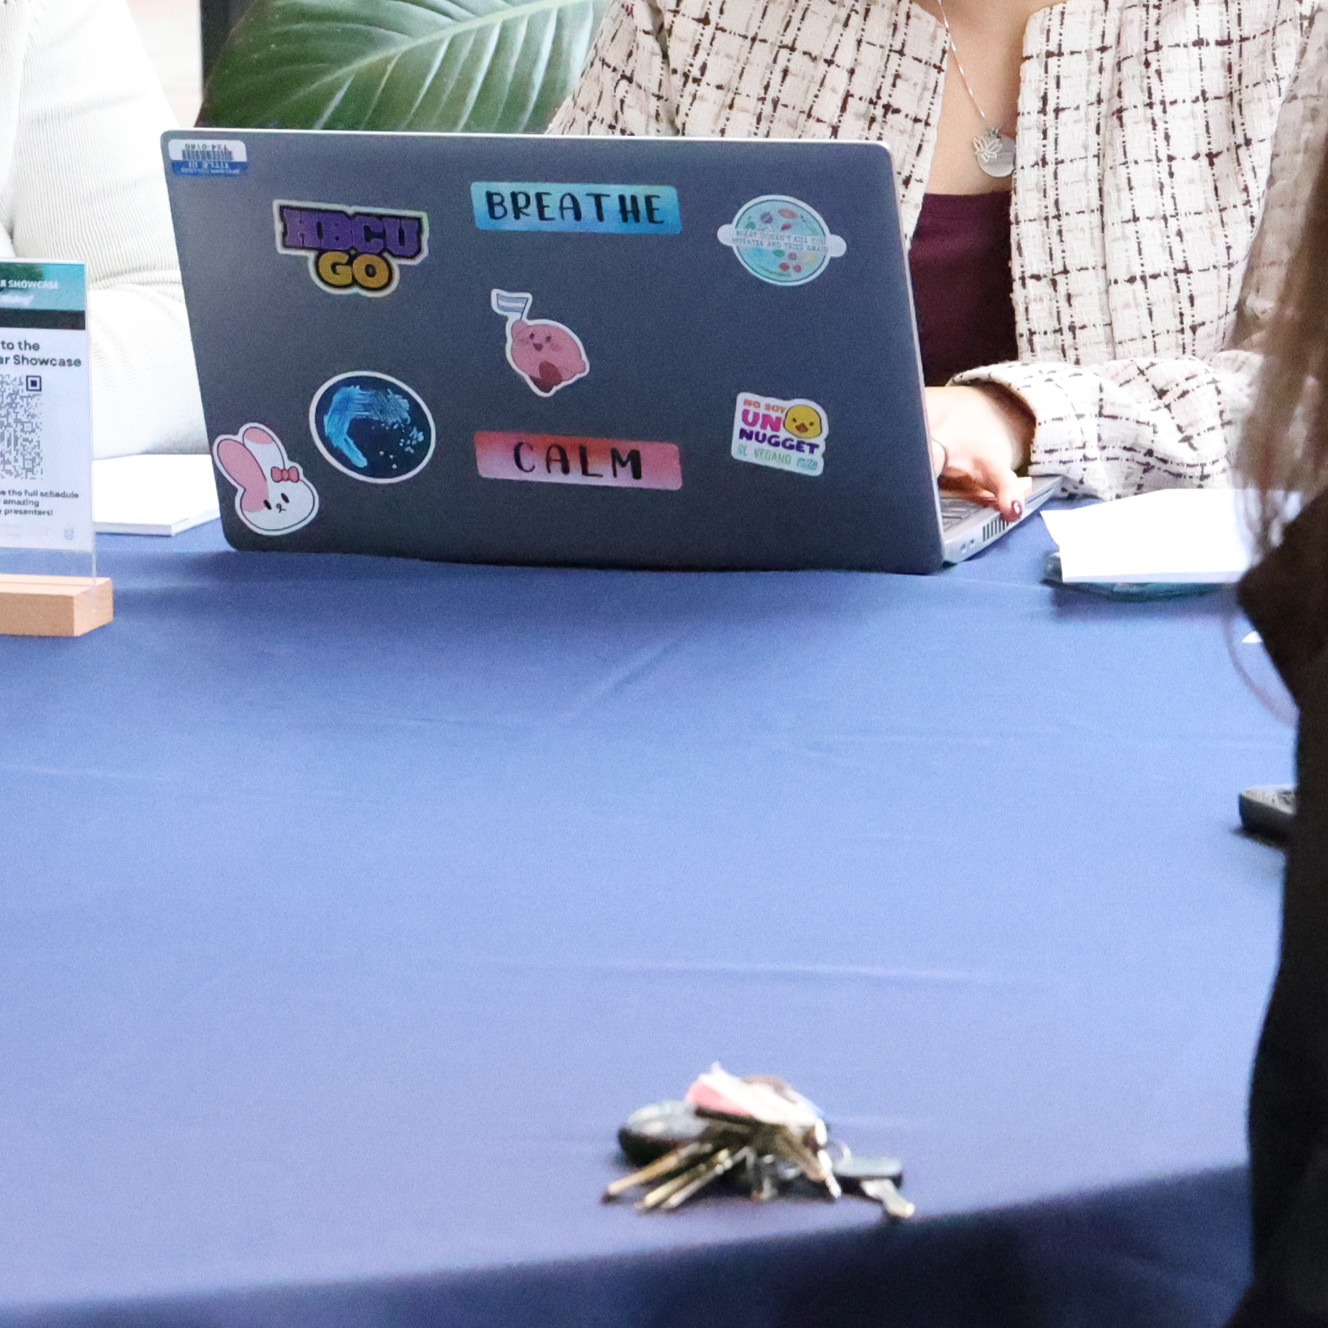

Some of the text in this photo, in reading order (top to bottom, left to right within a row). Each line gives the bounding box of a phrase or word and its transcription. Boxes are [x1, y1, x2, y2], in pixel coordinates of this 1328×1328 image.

[485, 190, 665, 224] BREATHE
[281, 207, 421, 257] HBCU
[317, 251, 391, 288] GO
[8, 280, 59, 290] SHOWCASE
[1, 340, 15, 351] to
[18, 340, 41, 352] the
[13, 354, 82, 367] Showcase
[743, 399, 761, 409] NO
[741, 408, 782, 432] UN
[739, 427, 820, 455] NUGGET
[513, 441, 642, 480] CALM
[3, 498, 40, 508] amazing
[8, 489, 23, 497] the
[24, 489, 39, 497] full
[40, 491, 79, 499] schedule
